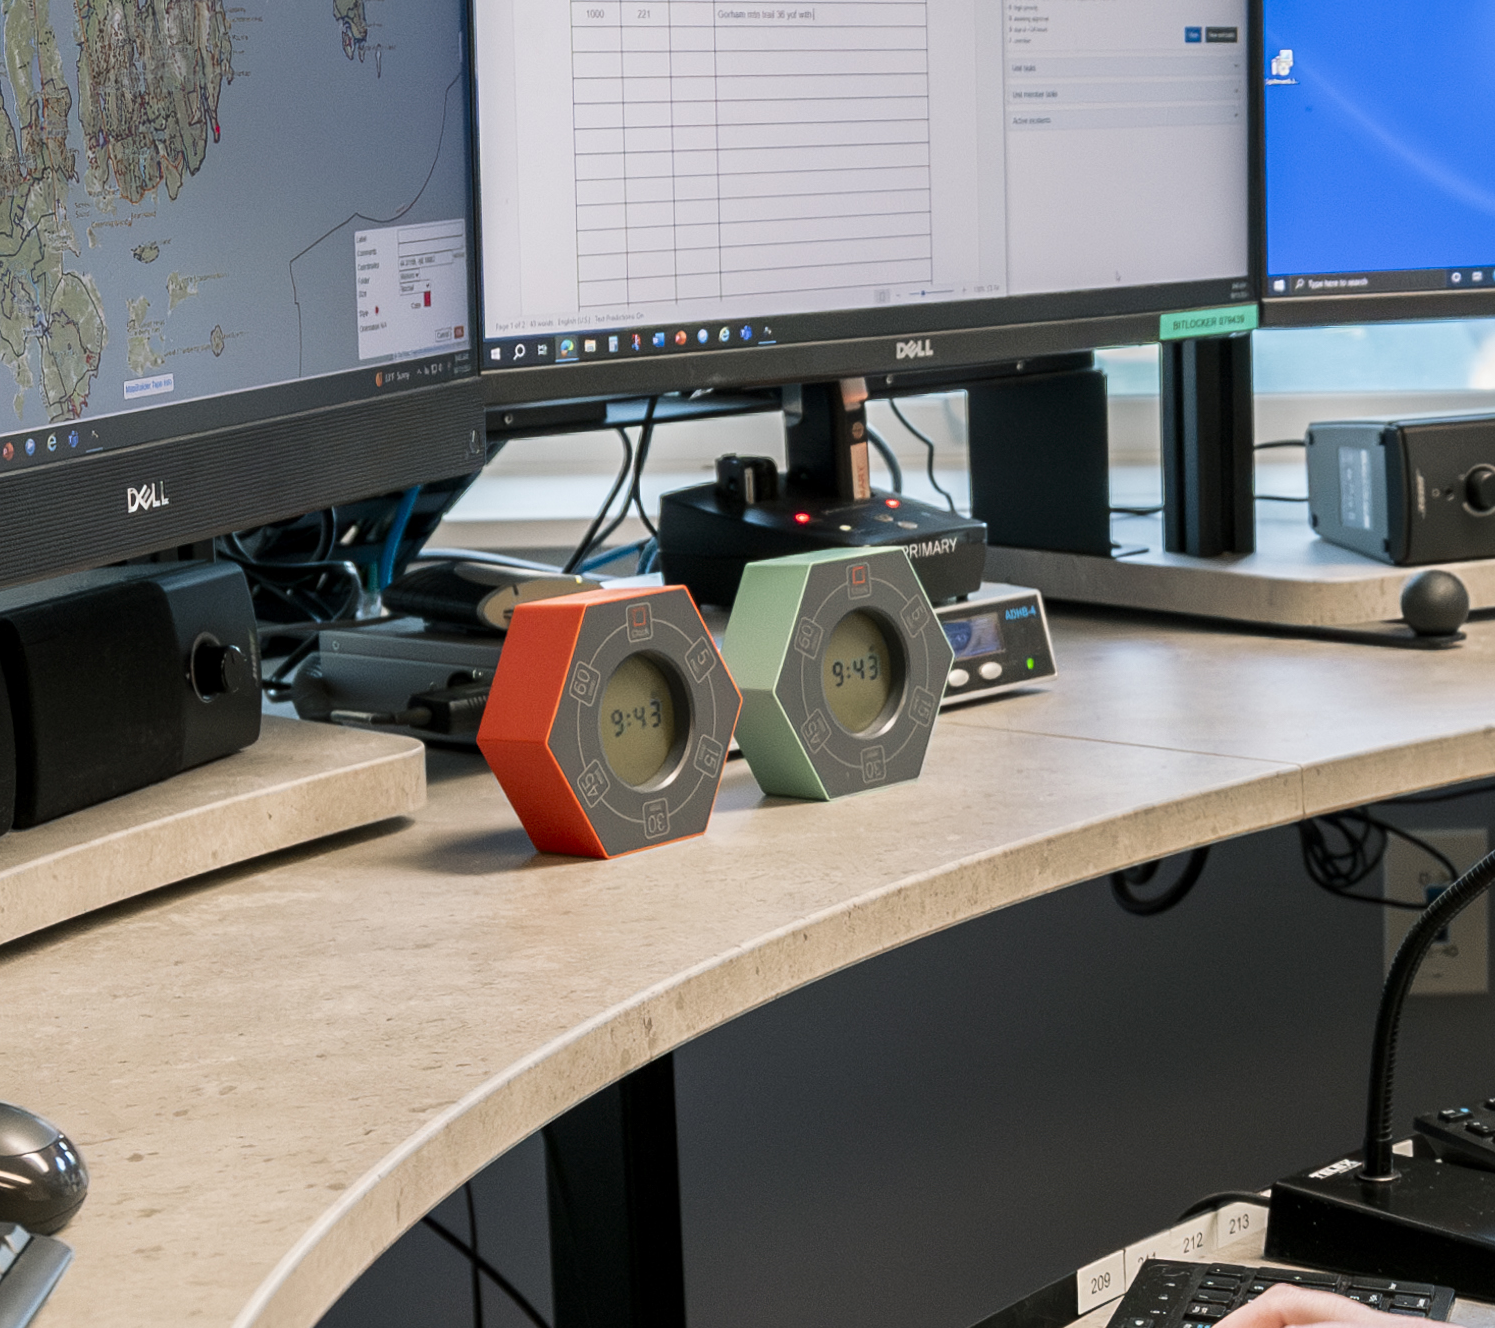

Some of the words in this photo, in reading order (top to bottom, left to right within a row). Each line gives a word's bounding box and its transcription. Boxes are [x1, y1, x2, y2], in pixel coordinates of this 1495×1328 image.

[585, 9, 605, 20] 1000
[637, 9, 651, 20] 221
[717, 10, 745, 20] Gorham
[776, 10, 786, 20] 36
[798, 10, 812, 20] with
[1308, 278, 1323, 289] Type
[1323, 278, 1338, 288] here
[1347, 277, 1368, 287] search
[495, 322, 509, 332] Page
[537, 320, 554, 328] words
[557, 318, 576, 328] English
[1173, 317, 1217, 330] BITLOCKER
[896, 339, 934, 359] DELL
[127, 480, 170, 514] DELL
[832, 655, 879, 687] 9:43
[610, 698, 662, 738] 9:43
[647, 813, 666, 834] 30
[1229, 1213, 1250, 1235] 213
[1183, 1232, 1203, 1254] 212
[1091, 1272, 1111, 1295] 209
